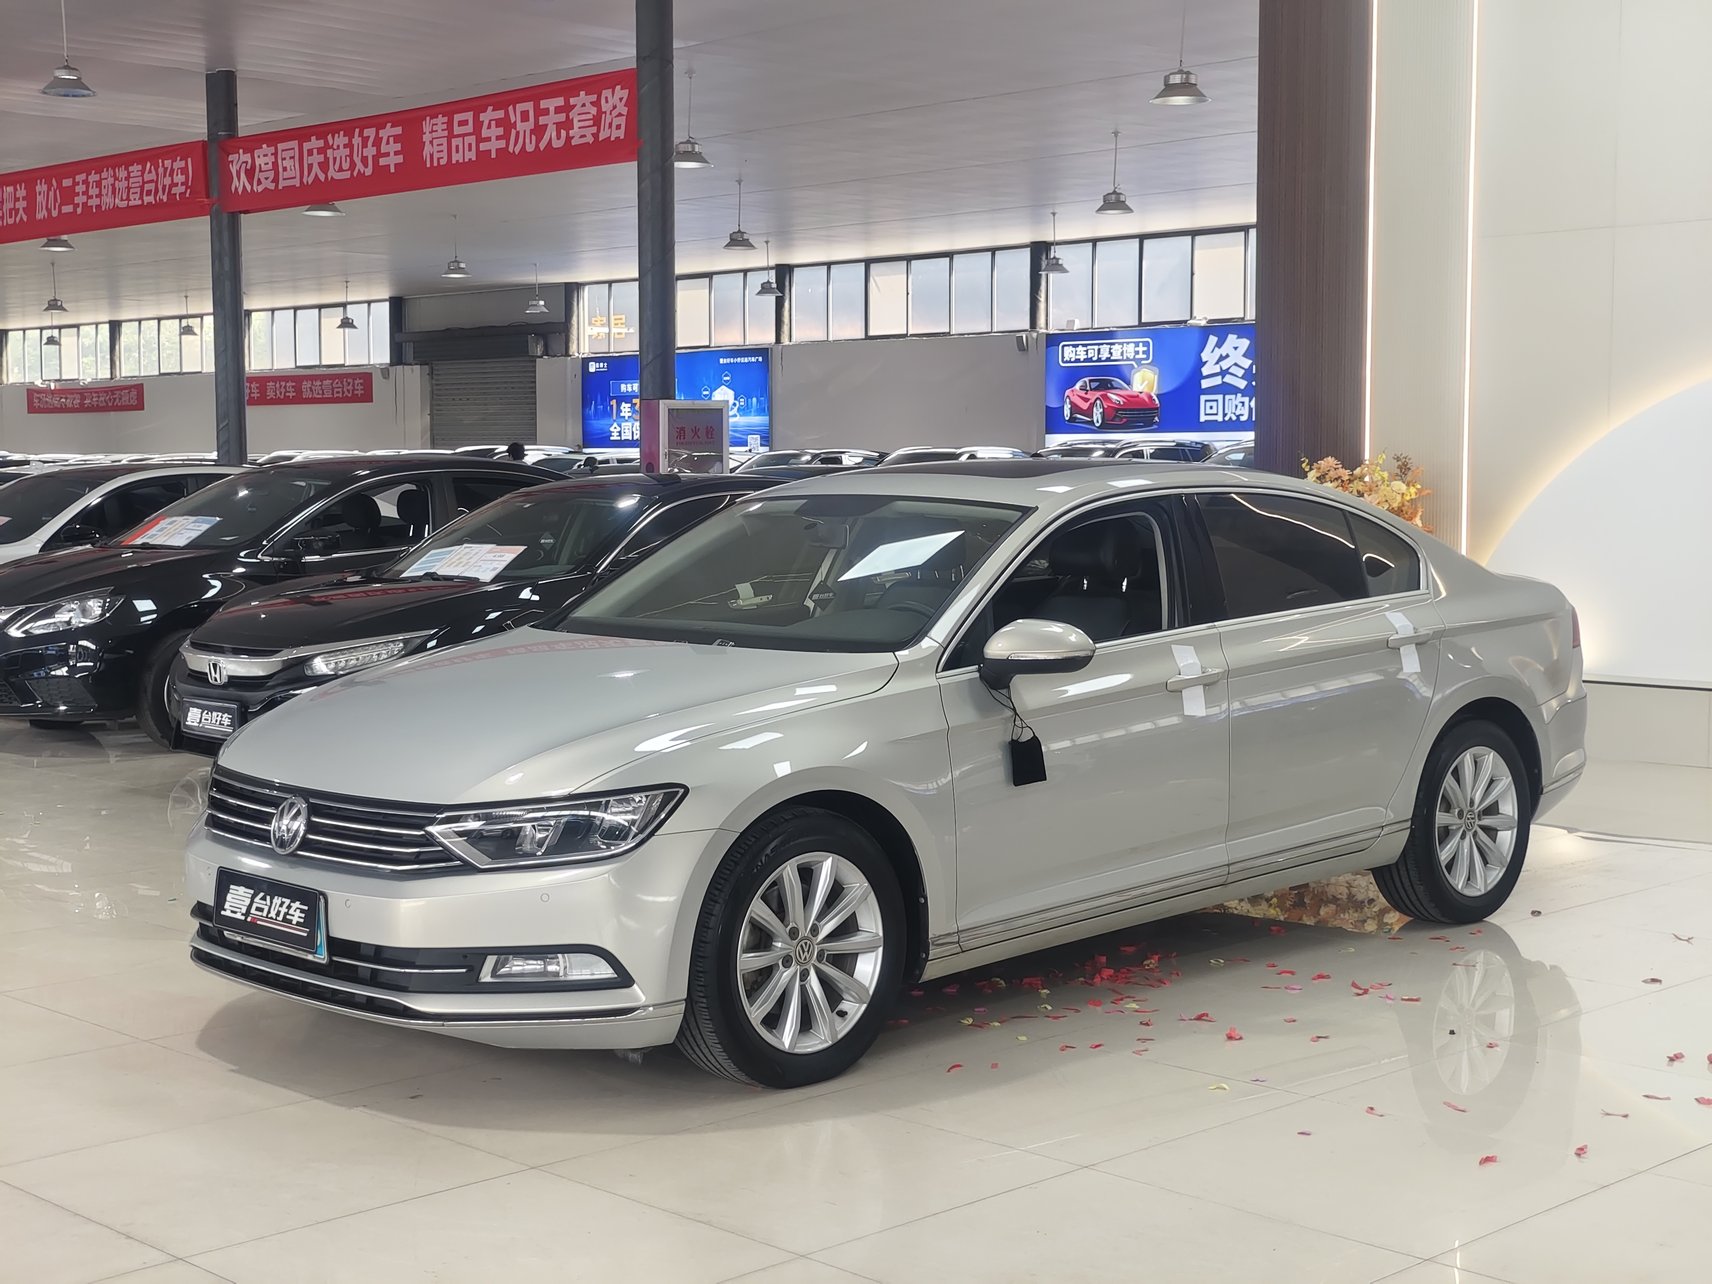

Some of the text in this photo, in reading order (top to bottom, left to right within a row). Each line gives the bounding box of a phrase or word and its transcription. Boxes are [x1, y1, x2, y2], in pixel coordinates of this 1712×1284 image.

[228, 84, 630, 195] 欢度国庆选好车 精品车况无套路
[0, 182, 27, 226] 把关
[1063, 343, 1148, 362] 购车可享查博士
[1200, 333, 1255, 390] 终
[266, 380, 296, 400] 卖好车
[302, 377, 365, 399] 就选壹台好车
[675, 425, 715, 440] 消火栓
[185, 706, 233, 727] 壹台好车
[221, 884, 309, 925] 壹台好车
